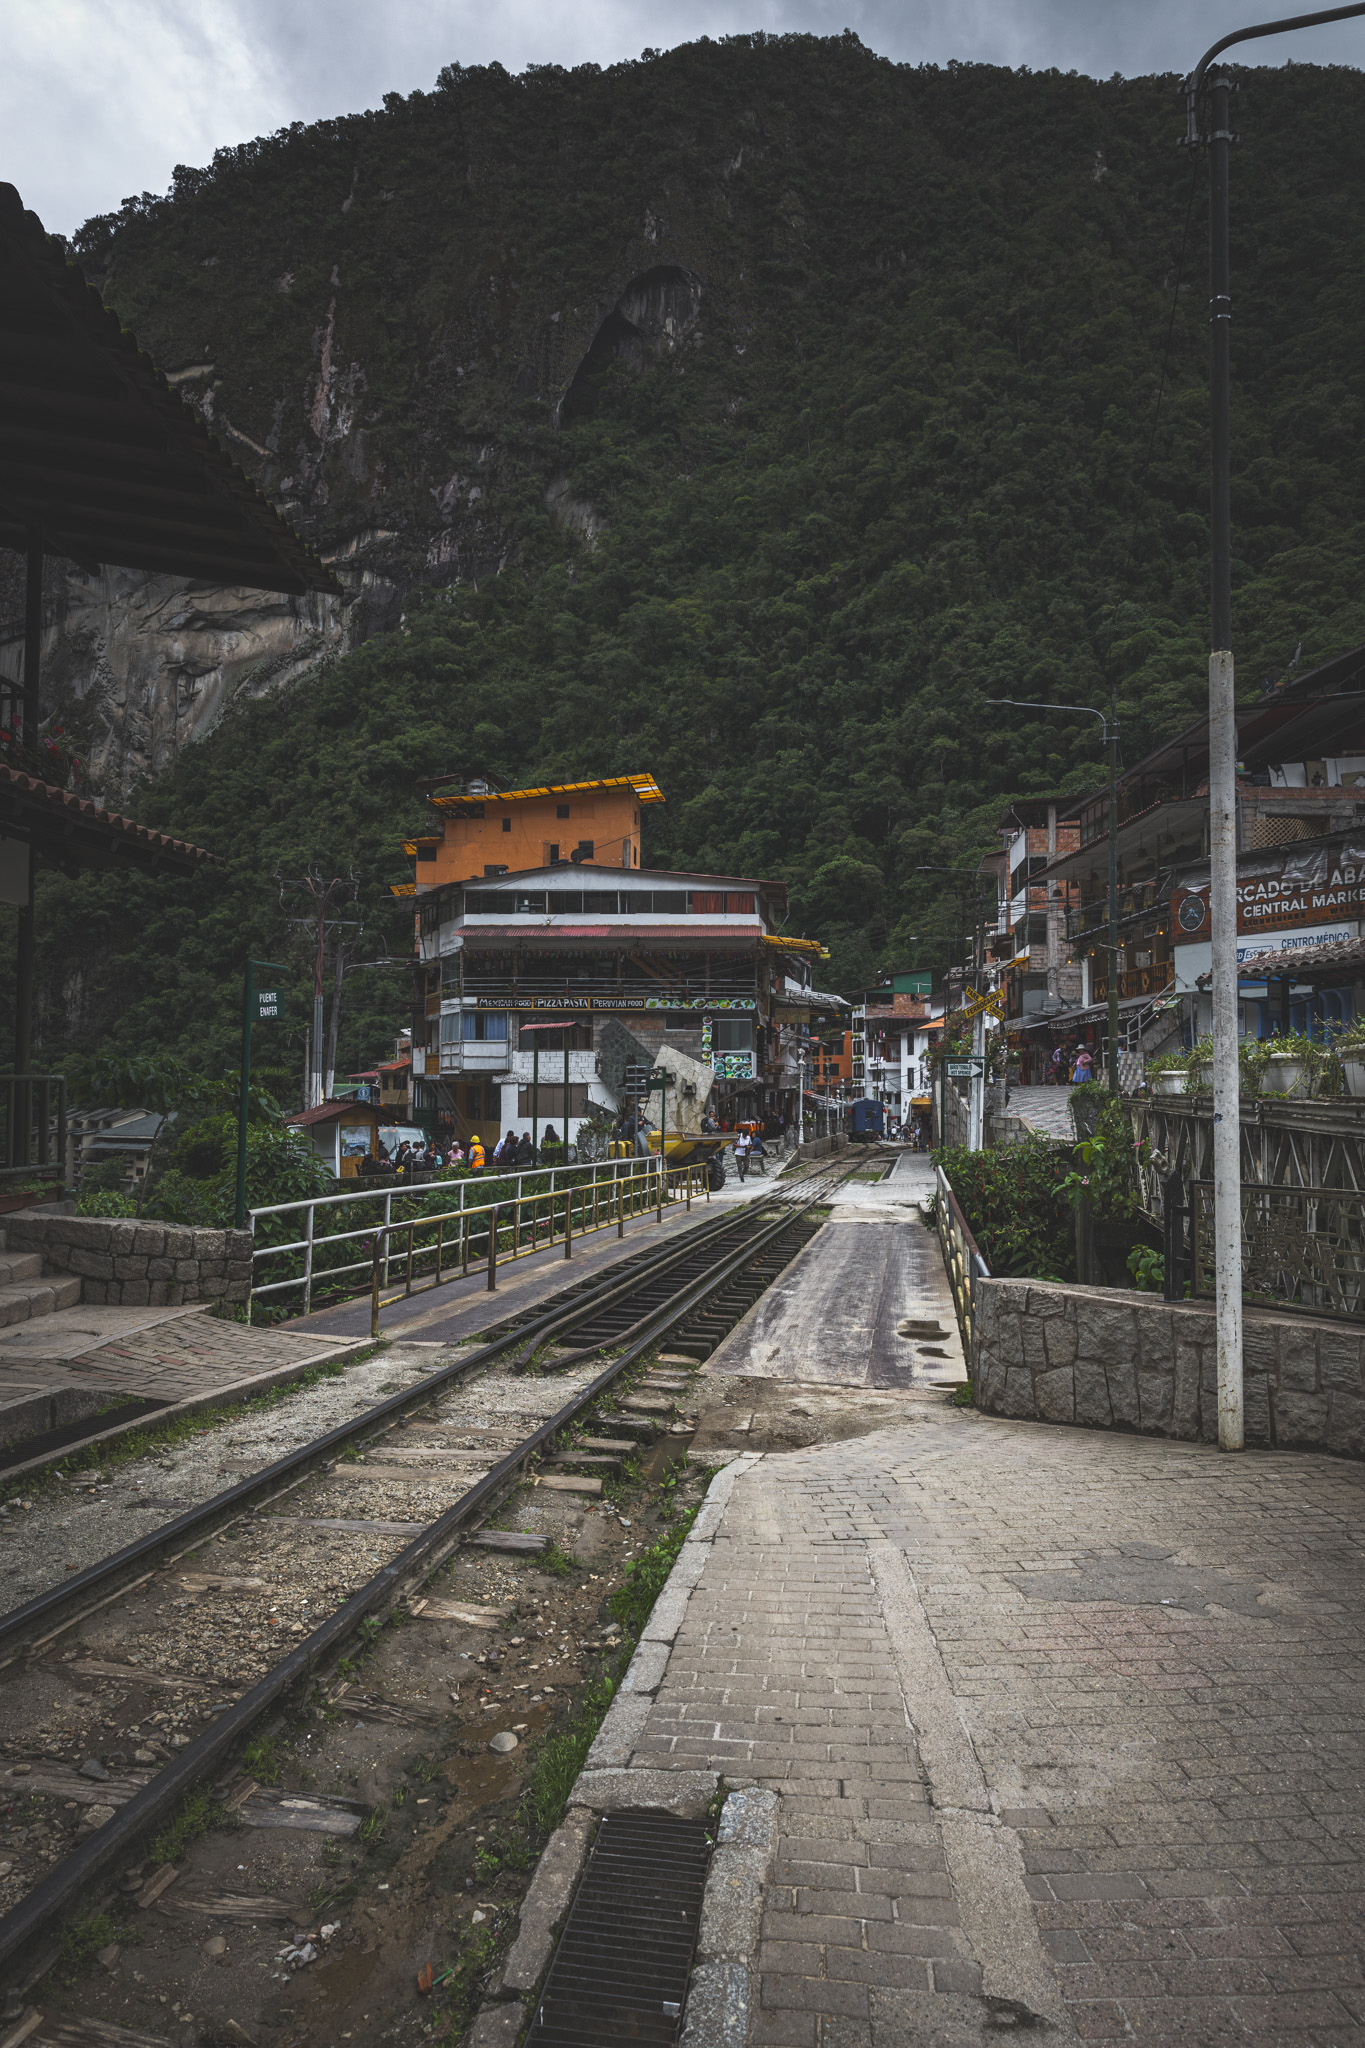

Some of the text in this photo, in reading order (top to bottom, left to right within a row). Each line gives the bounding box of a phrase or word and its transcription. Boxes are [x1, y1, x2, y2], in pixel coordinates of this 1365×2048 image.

[1243, 897, 1308, 918] CENTRAL
[1281, 936, 1314, 949] CENTRO
[259, 992, 277, 1003] PUENTE
[593, 999, 626, 1007] PERUVIAN
[967, 992, 1002, 1016] FERROCARRIL
[260, 1006, 278, 1017] ENAFER
